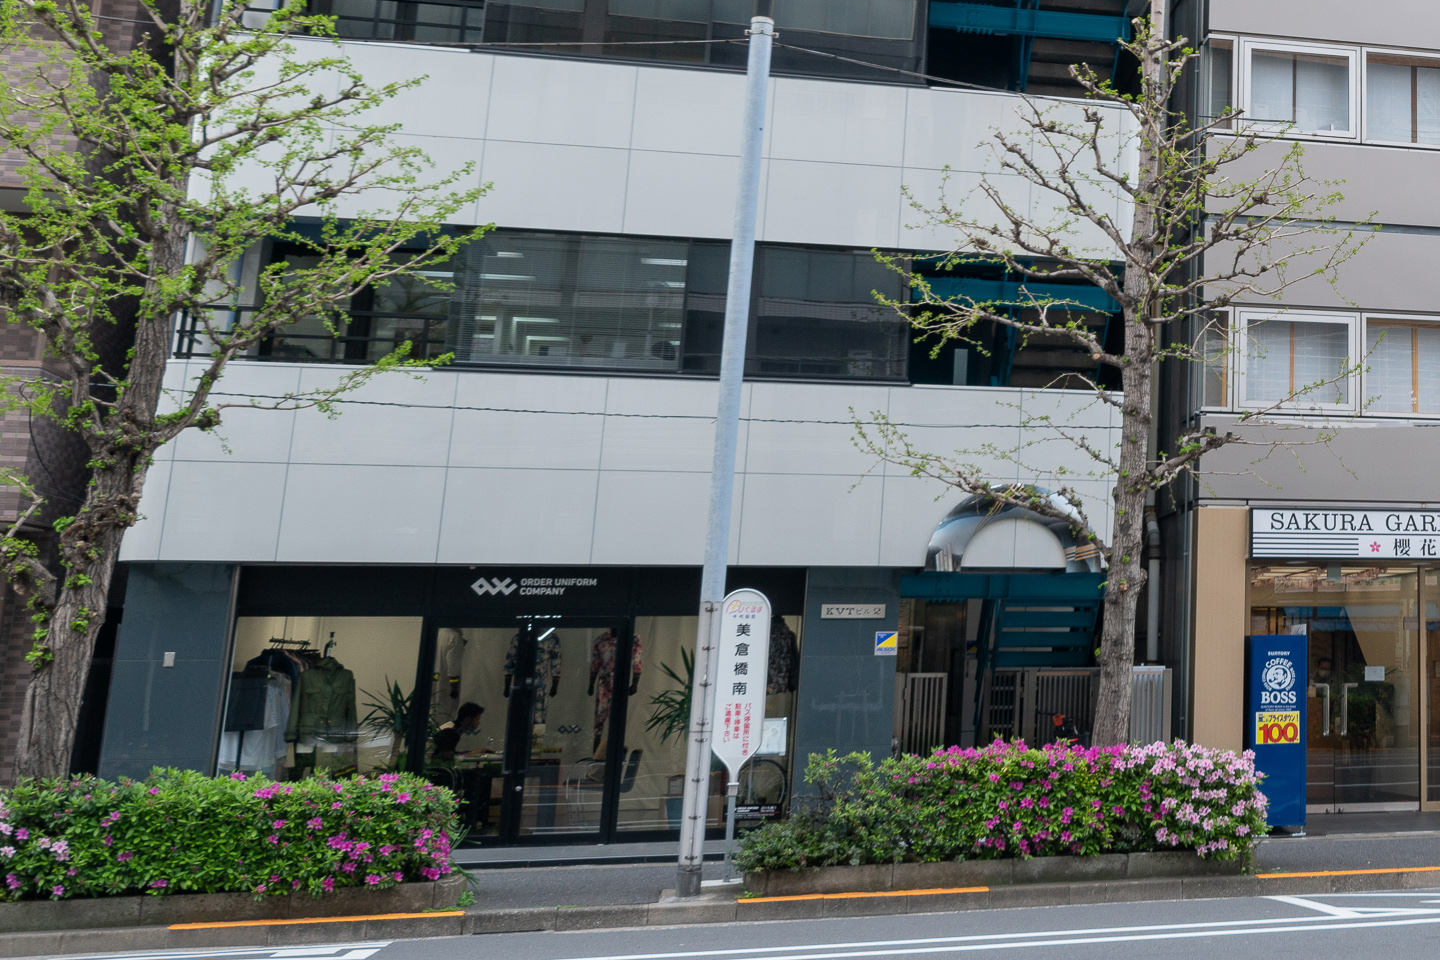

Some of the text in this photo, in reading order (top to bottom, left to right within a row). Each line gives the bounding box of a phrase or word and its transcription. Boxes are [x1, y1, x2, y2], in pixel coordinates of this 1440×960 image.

[1270, 512, 1374, 531] SAKURA
[520, 577, 598, 586] ORDER UNIFORM
[519, 587, 566, 596] COMPANY
[731, 623, 752, 696] 美倉橋南
[1266, 658, 1292, 668] COFFEE
[1261, 691, 1296, 704] BOSS
